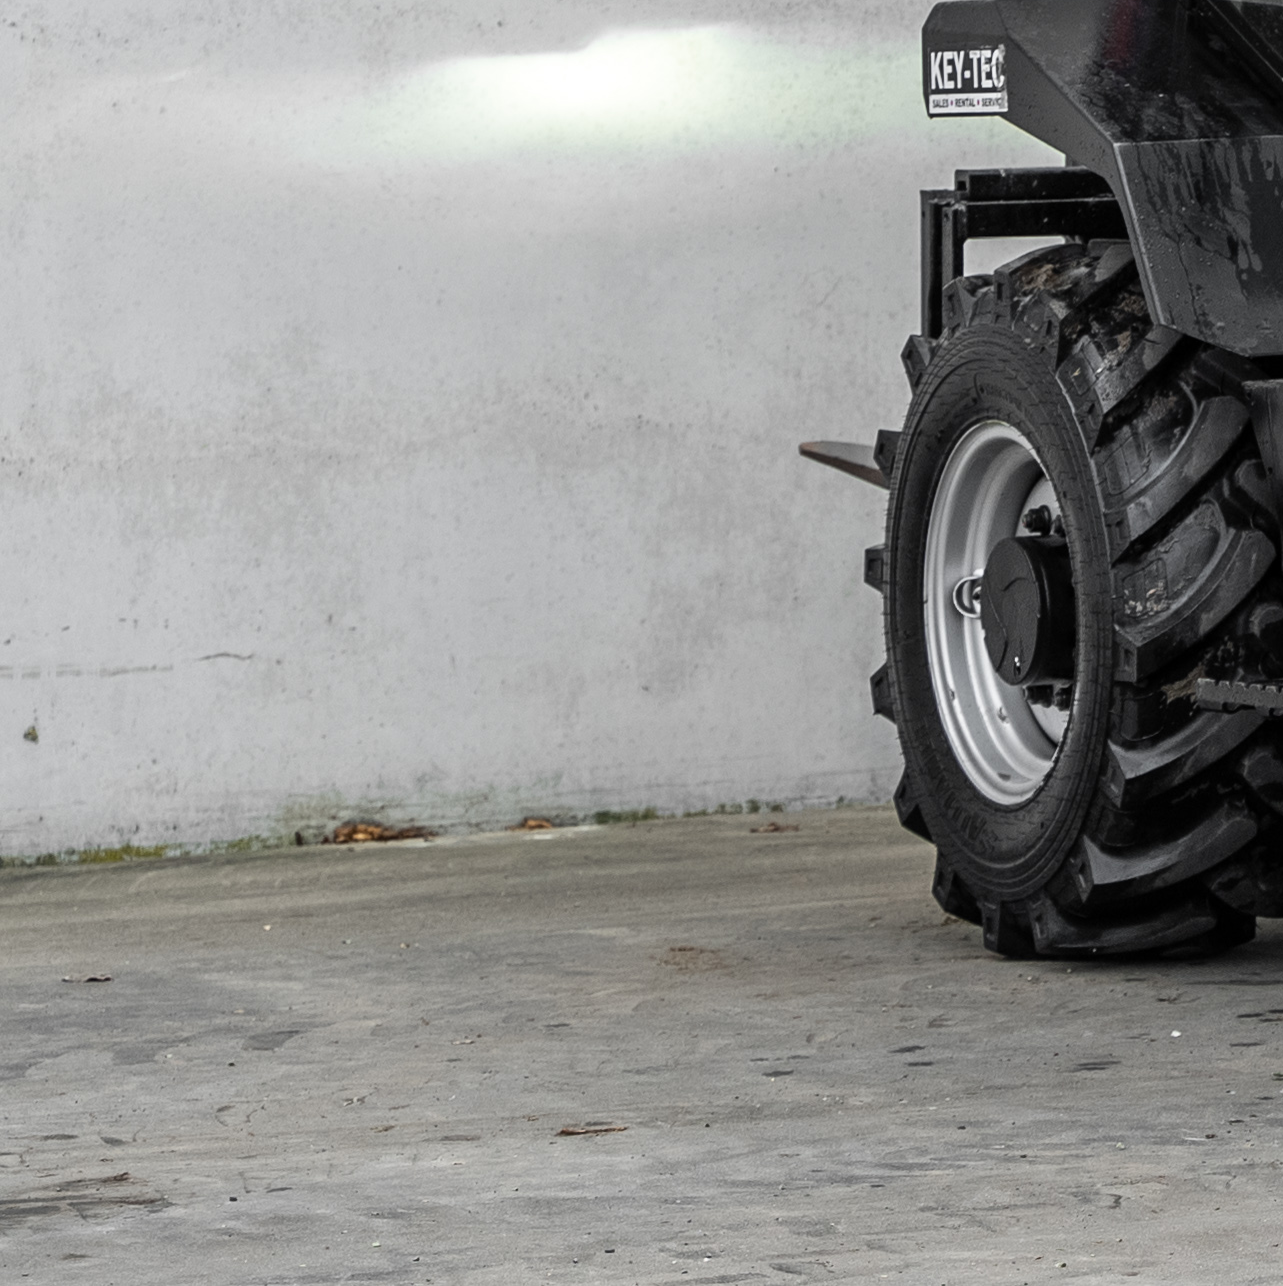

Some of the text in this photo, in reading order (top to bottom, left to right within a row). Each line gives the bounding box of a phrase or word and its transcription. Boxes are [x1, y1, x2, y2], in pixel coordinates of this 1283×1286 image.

[930, 47, 1005, 90] KEY-TEC
[933, 98, 949, 108] SALES
[955, 97, 975, 108] RENTAL
